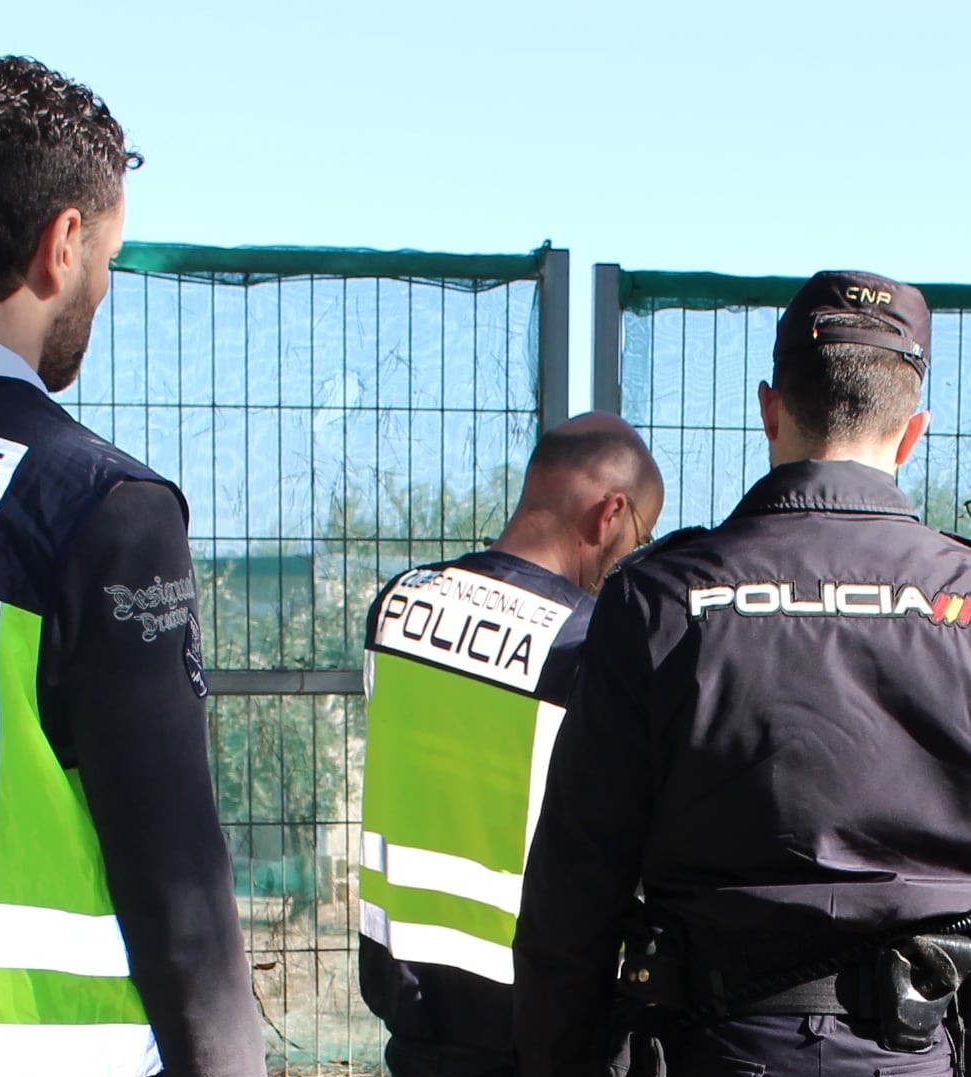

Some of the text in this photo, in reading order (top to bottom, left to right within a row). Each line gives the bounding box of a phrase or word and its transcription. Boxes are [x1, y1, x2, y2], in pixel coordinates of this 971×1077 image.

[846, 286, 892, 304] CNP
[455, 579, 526, 620] NACIONAL
[529, 605, 559, 629] DE
[690, 581, 935, 617] POLICIA
[380, 594, 534, 676] POLICIA
